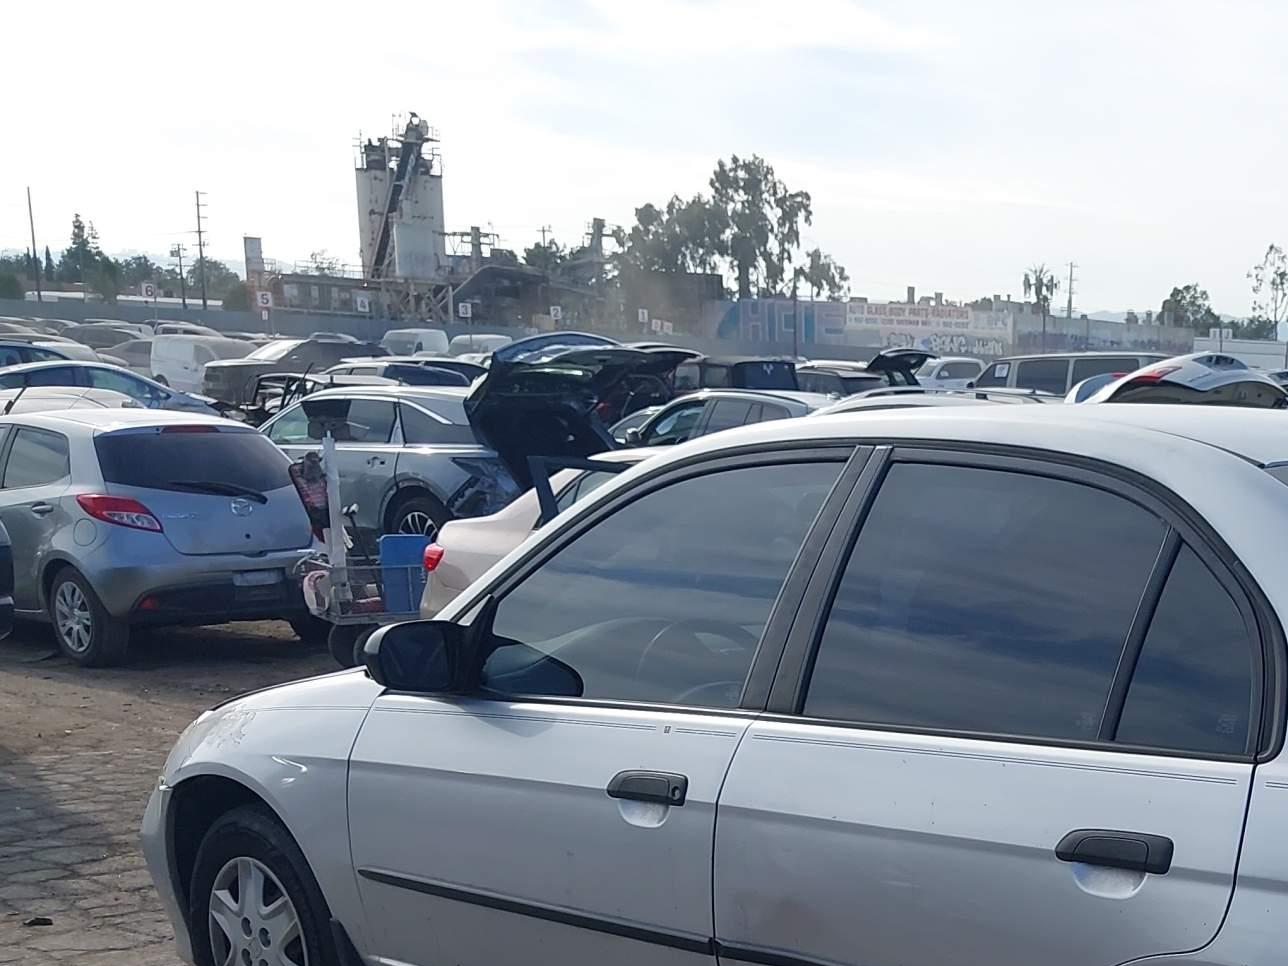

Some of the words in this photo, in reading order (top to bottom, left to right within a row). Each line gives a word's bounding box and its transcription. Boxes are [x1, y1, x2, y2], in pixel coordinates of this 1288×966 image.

[145, 285, 153, 297] 6
[261, 293, 270, 305] 5
[552, 307, 560, 318] 2
